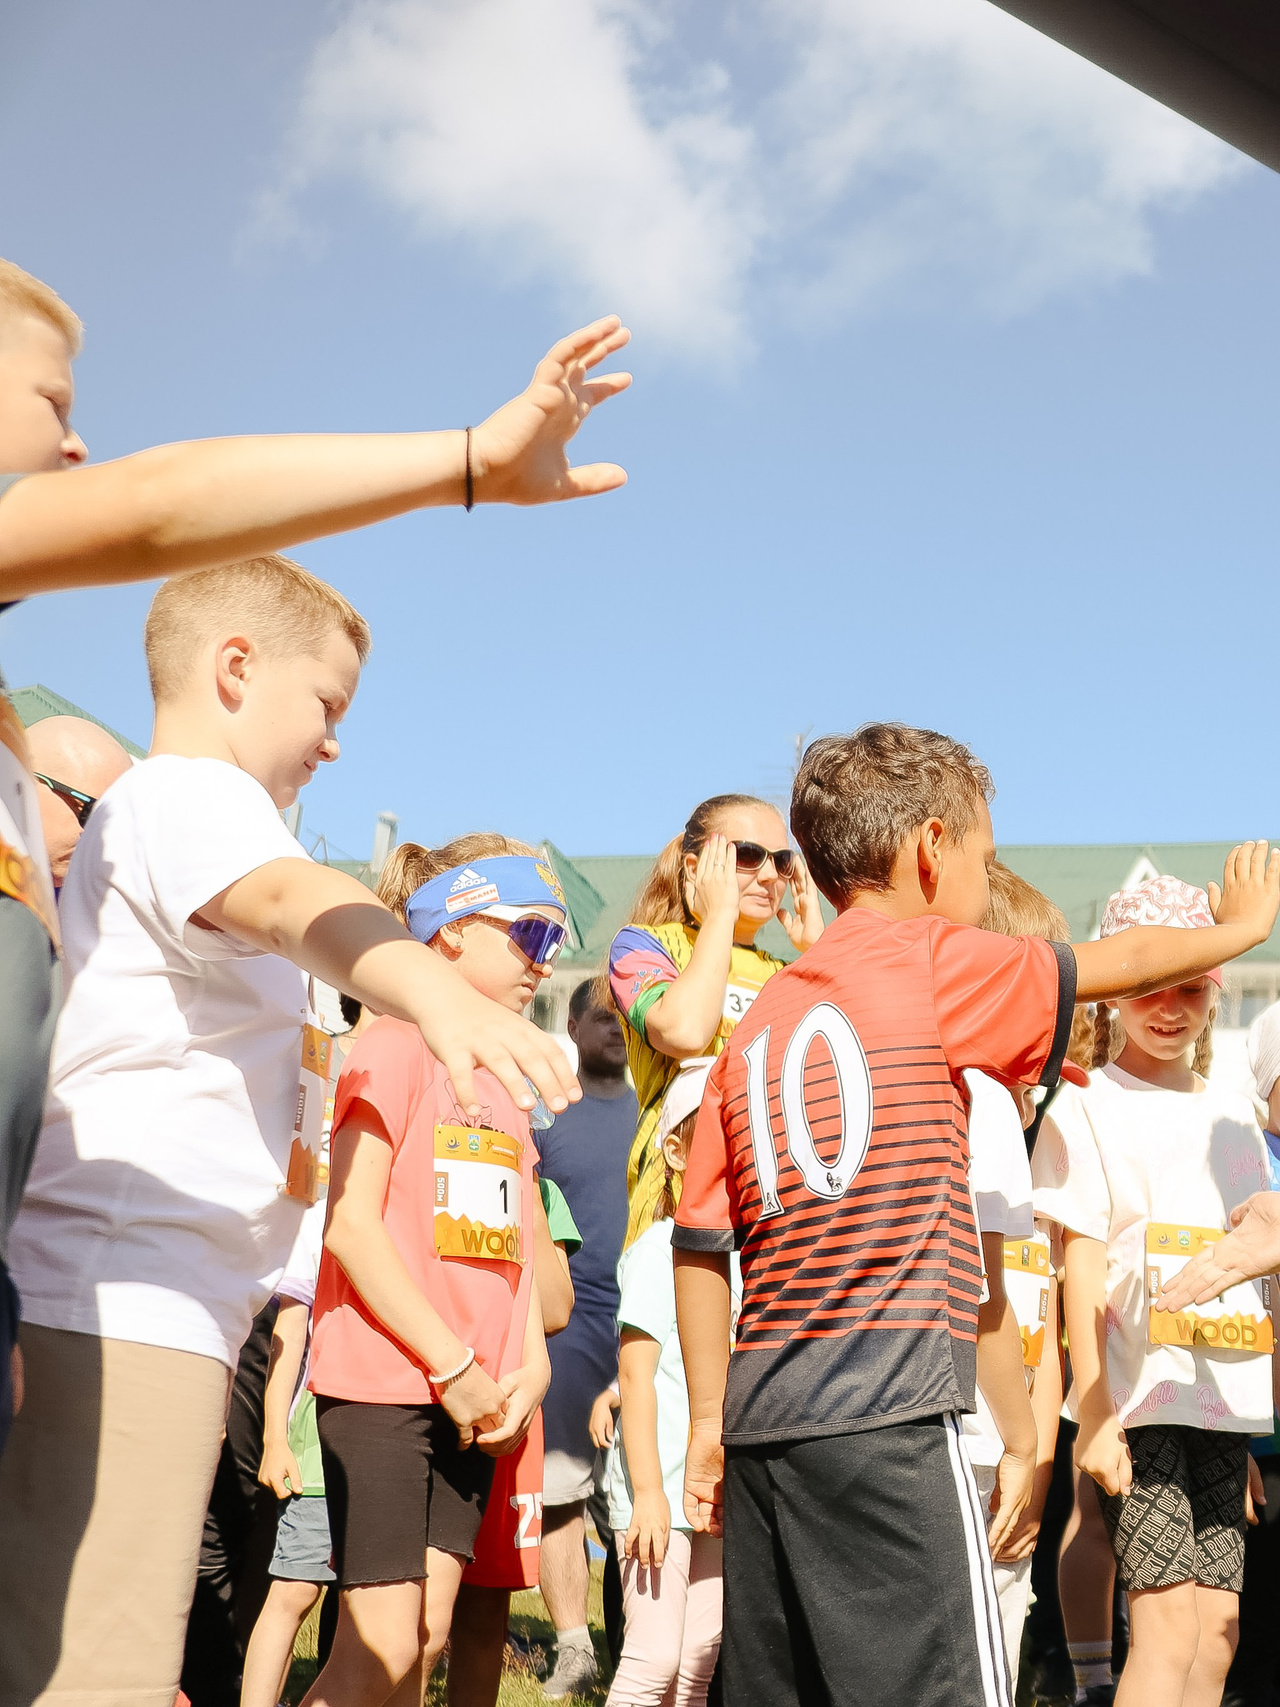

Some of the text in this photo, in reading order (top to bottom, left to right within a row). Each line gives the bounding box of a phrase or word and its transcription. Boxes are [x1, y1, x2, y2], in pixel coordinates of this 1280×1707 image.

[741, 1001, 874, 1221] 10
[499, 1179, 508, 1214] 1
[1175, 1318, 1258, 1346] WOOD
